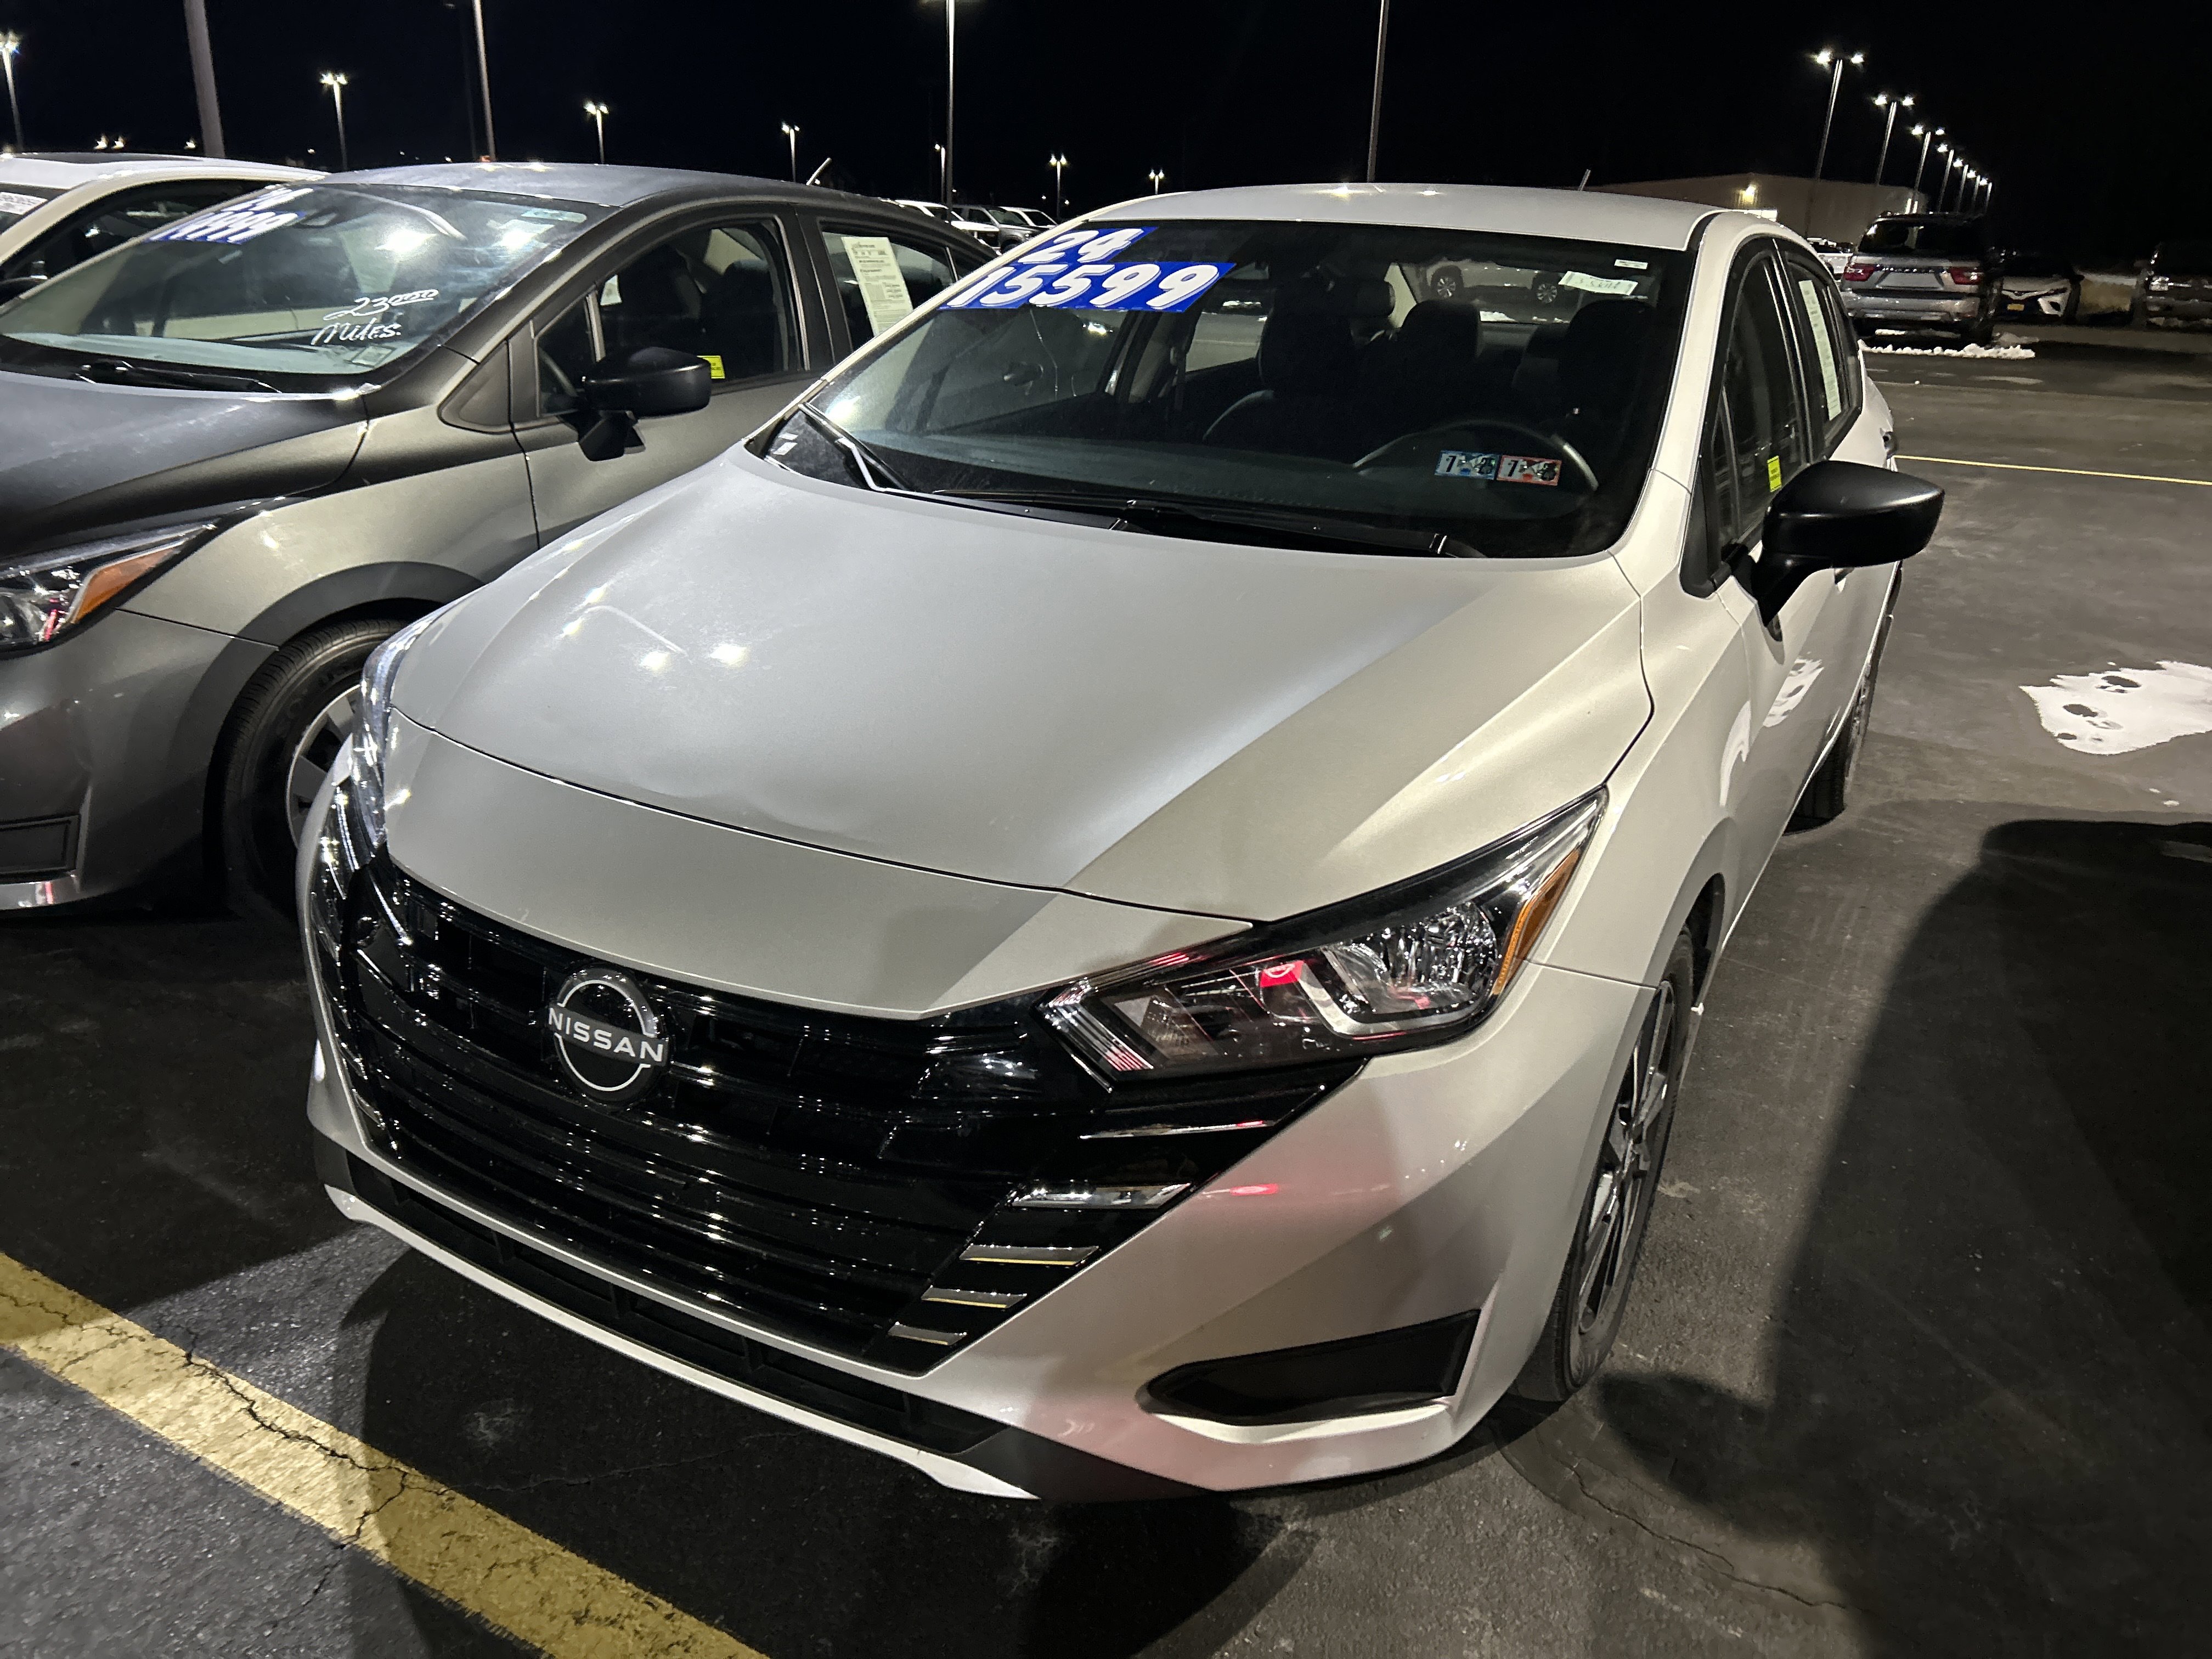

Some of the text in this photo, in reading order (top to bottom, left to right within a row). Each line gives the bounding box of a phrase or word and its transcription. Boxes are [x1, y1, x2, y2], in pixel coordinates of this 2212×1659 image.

[1018, 228, 1145, 265] 24
[946, 263, 1219, 309] 15599
[548, 1007, 664, 1062] NISSAN
